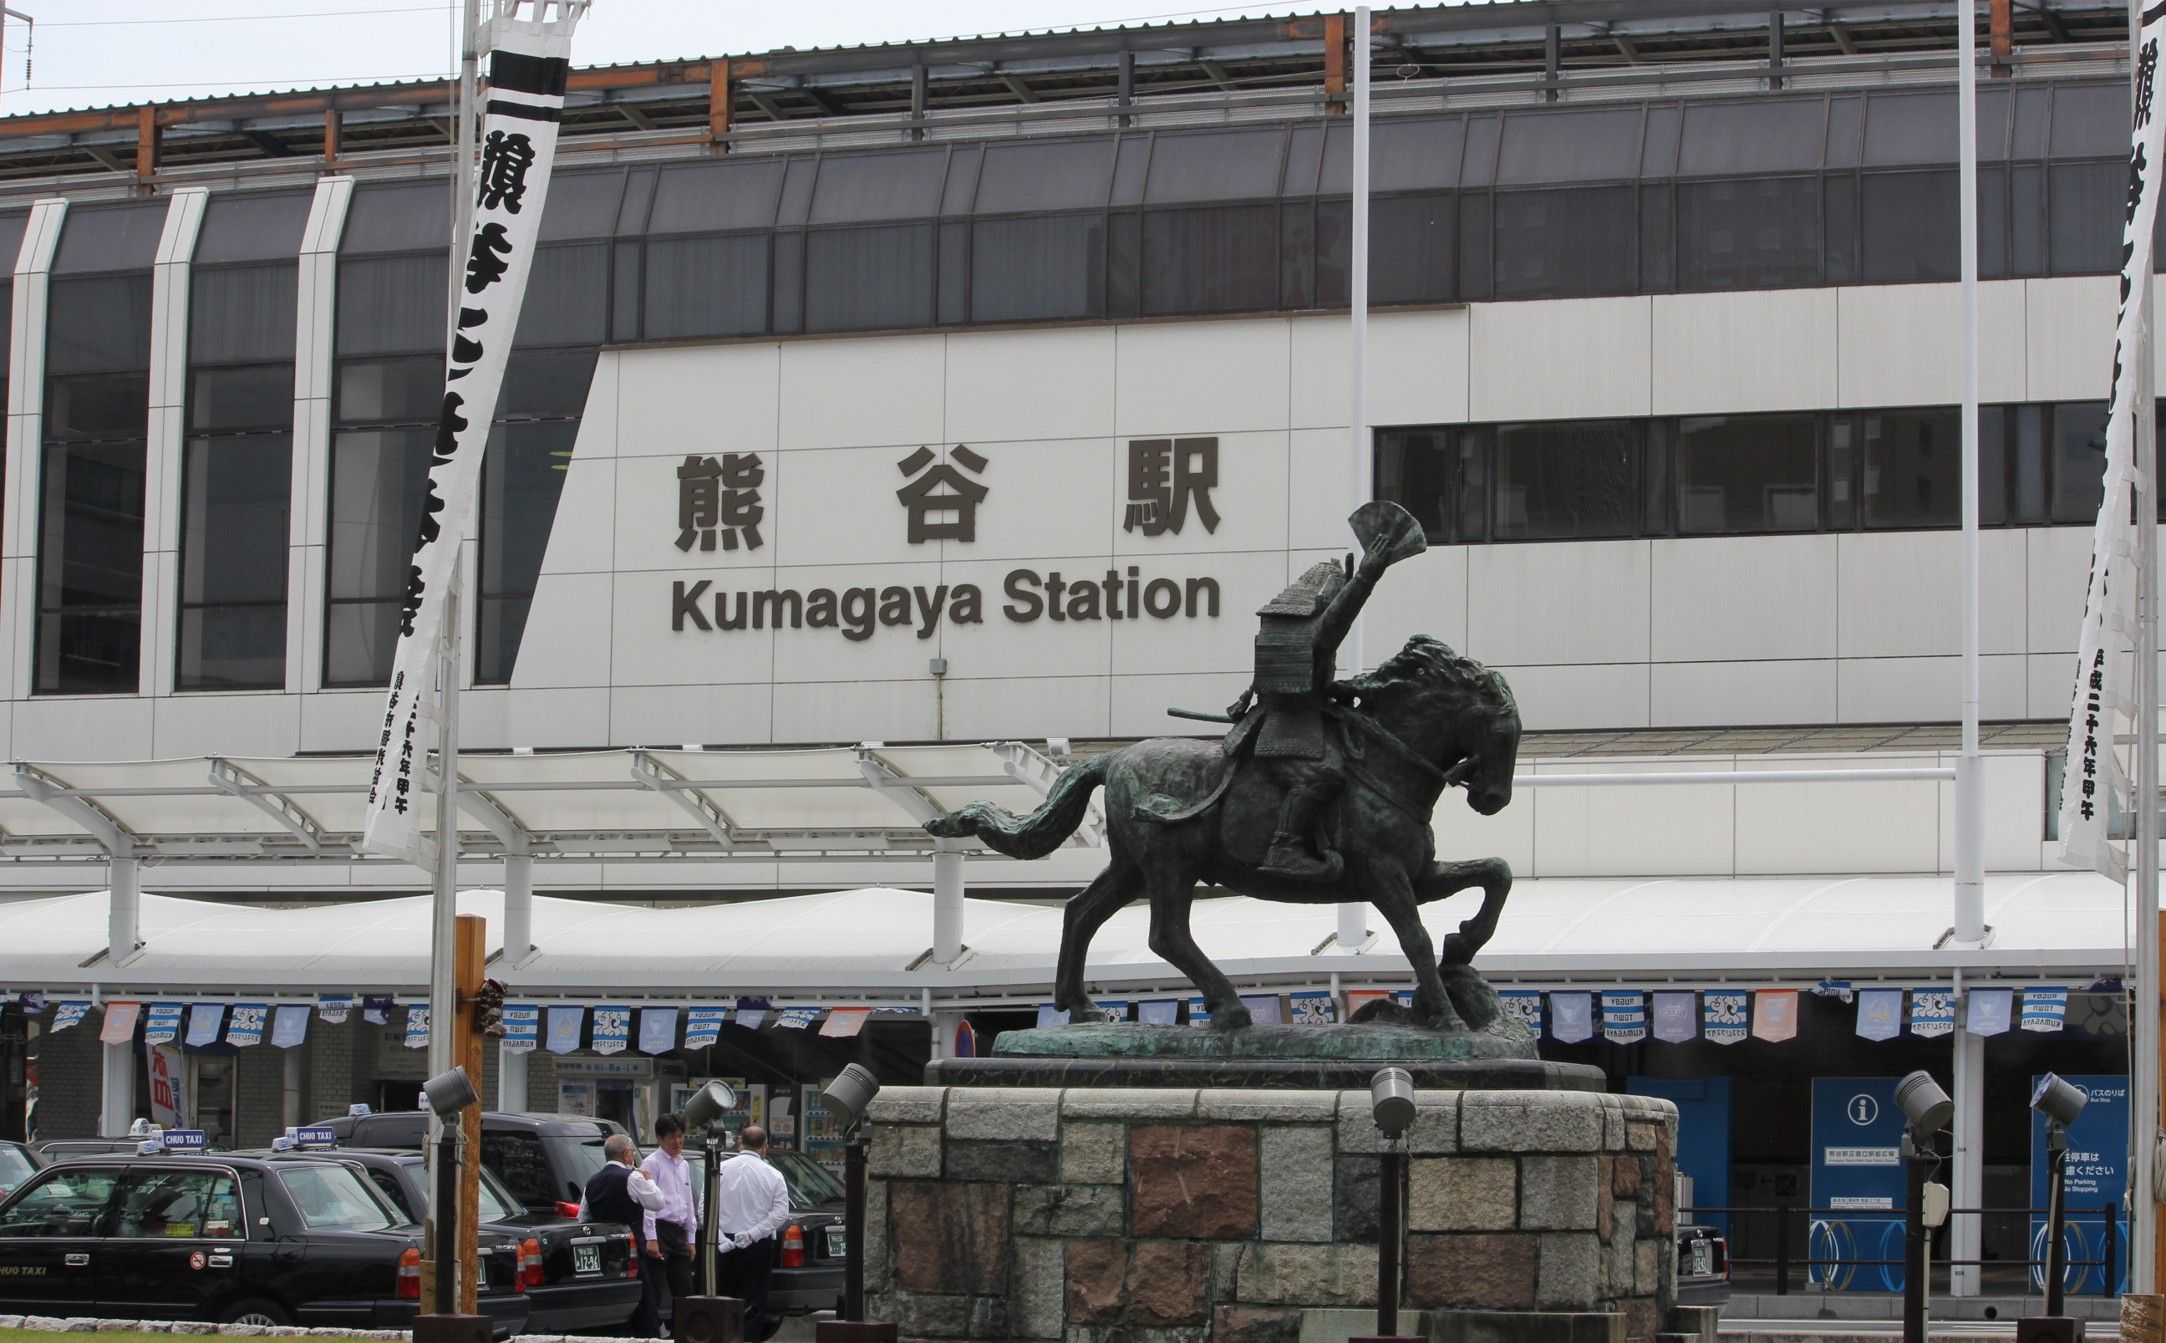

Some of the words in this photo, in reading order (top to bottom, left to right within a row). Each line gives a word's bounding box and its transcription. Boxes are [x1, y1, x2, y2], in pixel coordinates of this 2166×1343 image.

[674, 437, 1221, 553] 熊谷駅
[671, 580, 983, 642] Kumagaya
[1002, 566, 1221, 623] Station
[2090, 1089, 2126, 1097] バスのりば
[165, 1135, 184, 1144] CHUO
[185, 1135, 203, 1144] TAXI
[299, 1131, 316, 1140] CHUO
[317, 1131, 332, 1140] TAXI
[2074, 1179, 2097, 1187] Parking
[2072, 1186, 2099, 1194] Stopping
[21, 1266, 47, 1276] TAXI
